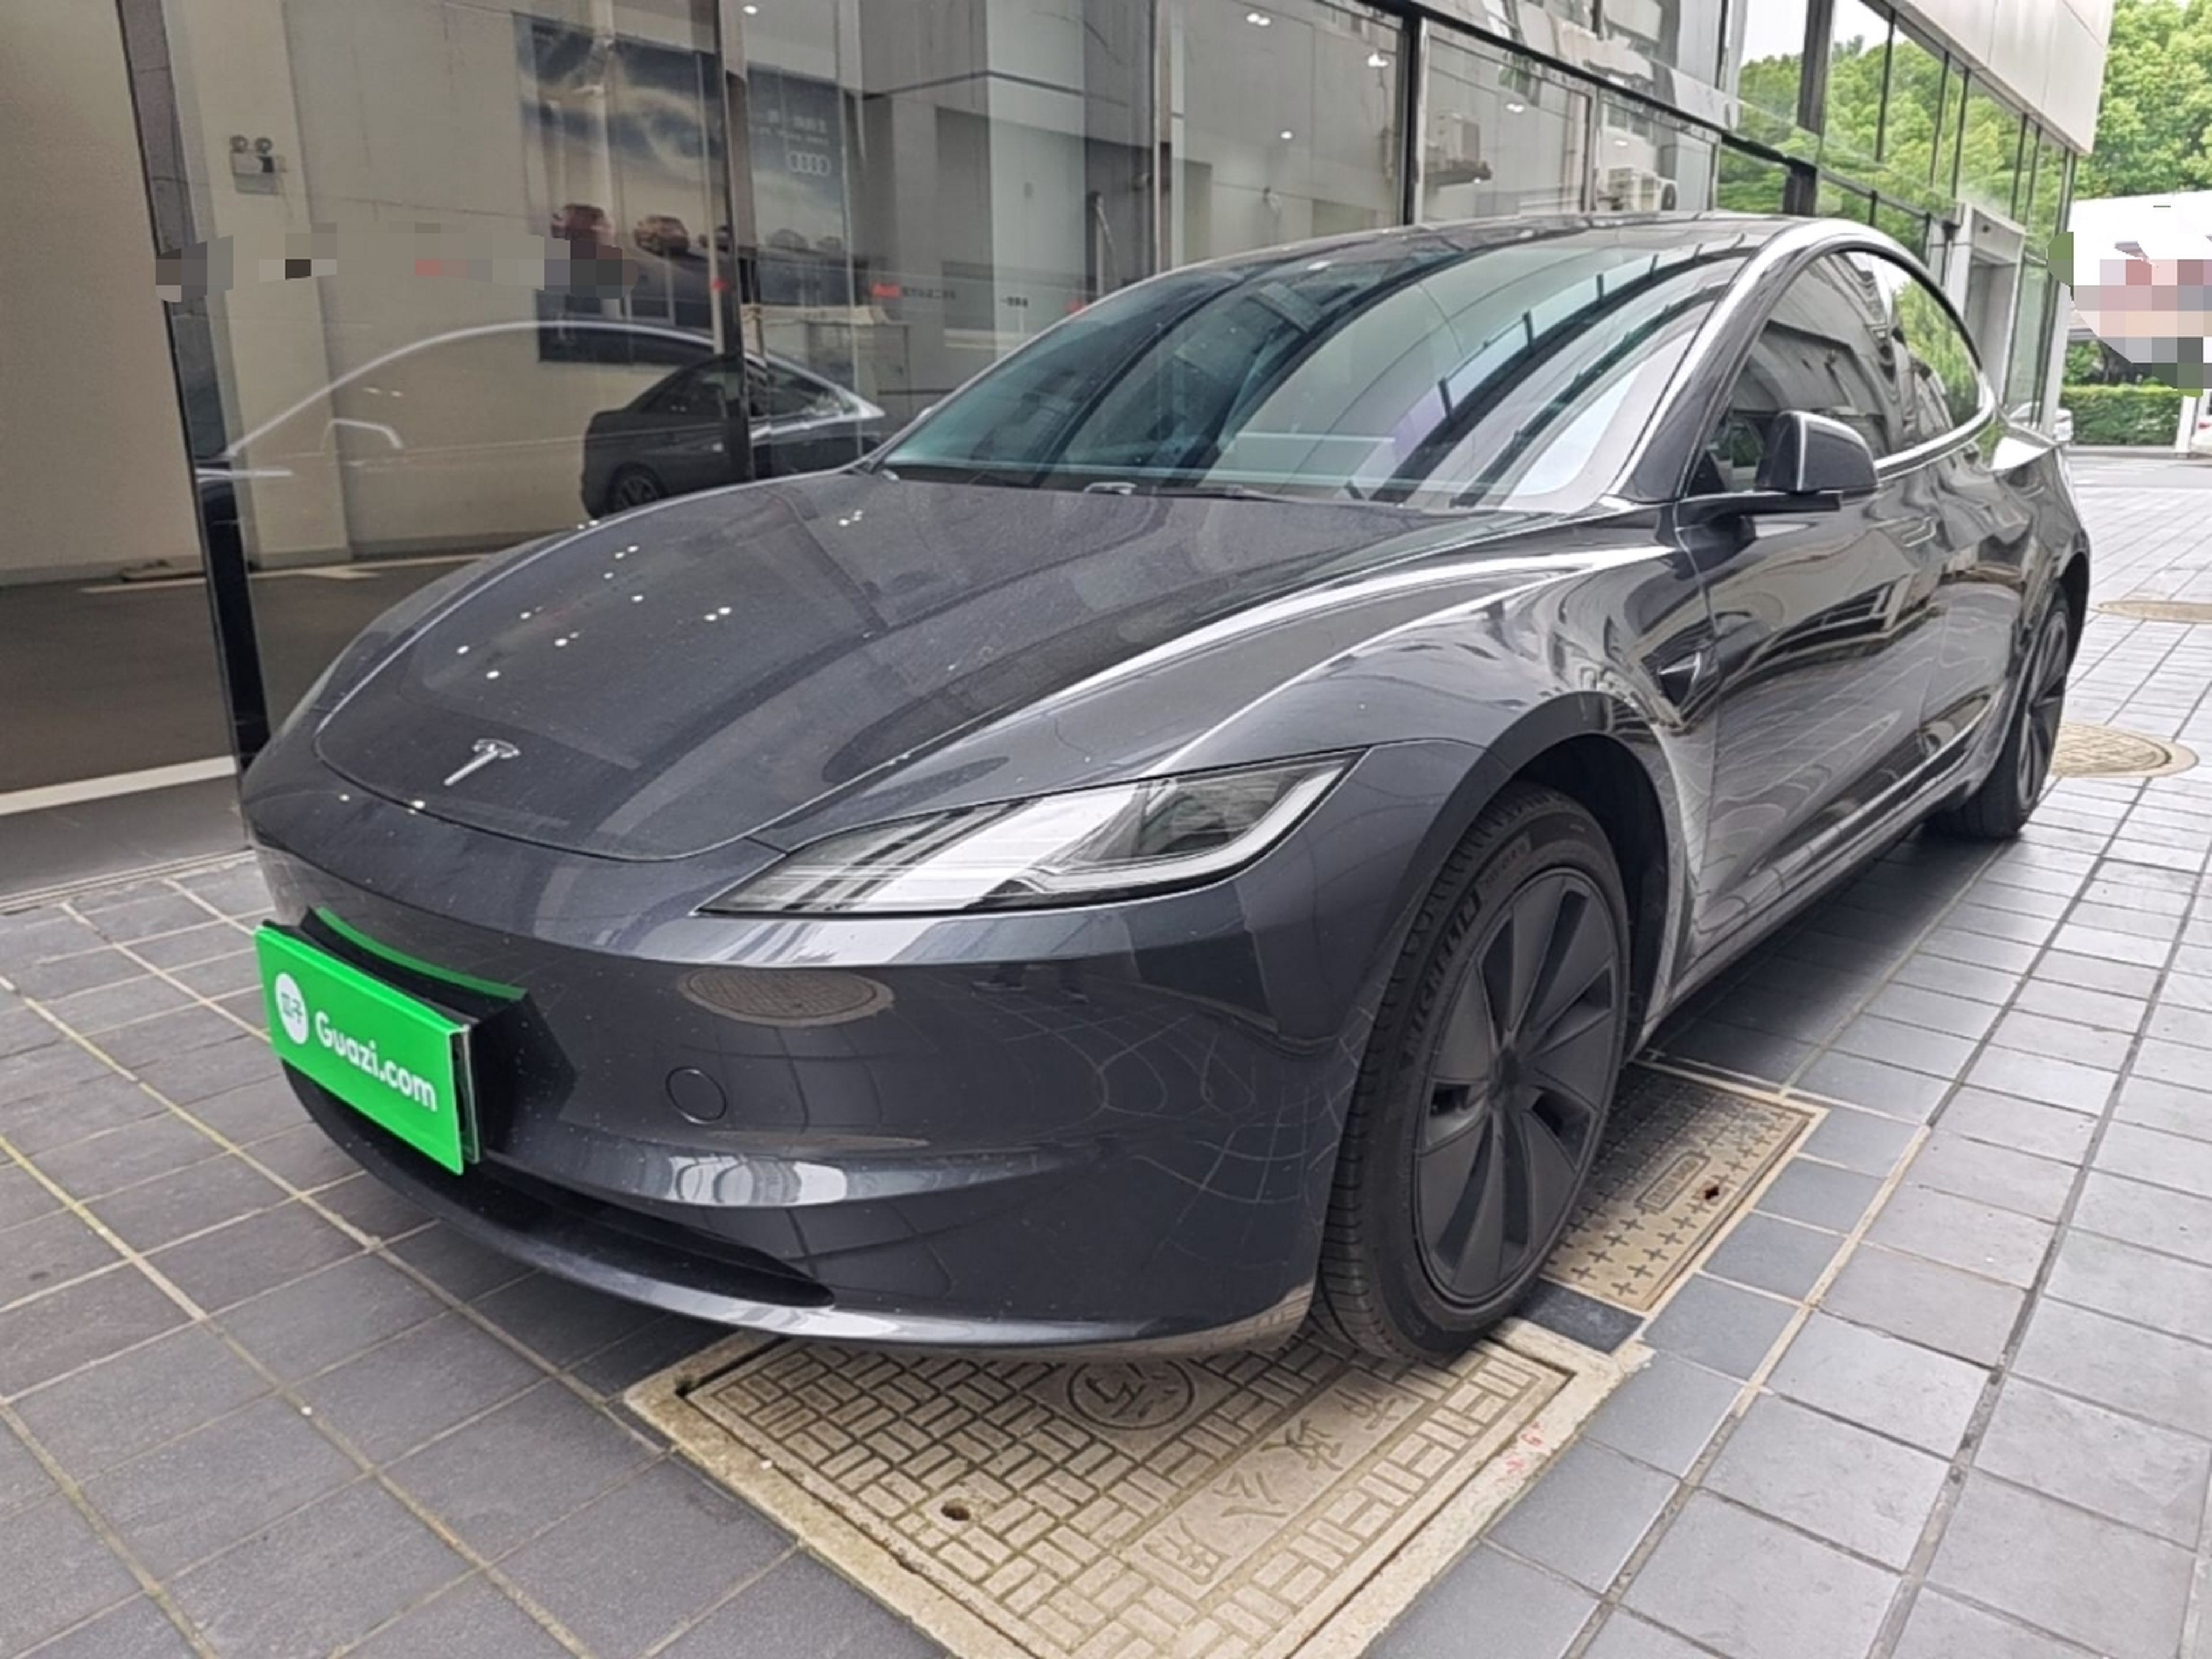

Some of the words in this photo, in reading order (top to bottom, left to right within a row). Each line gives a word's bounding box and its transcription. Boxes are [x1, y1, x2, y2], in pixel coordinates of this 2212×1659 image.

[315, 1011, 437, 1112] Guazi.com
[1146, 1388, 1406, 1585] 市政公用
